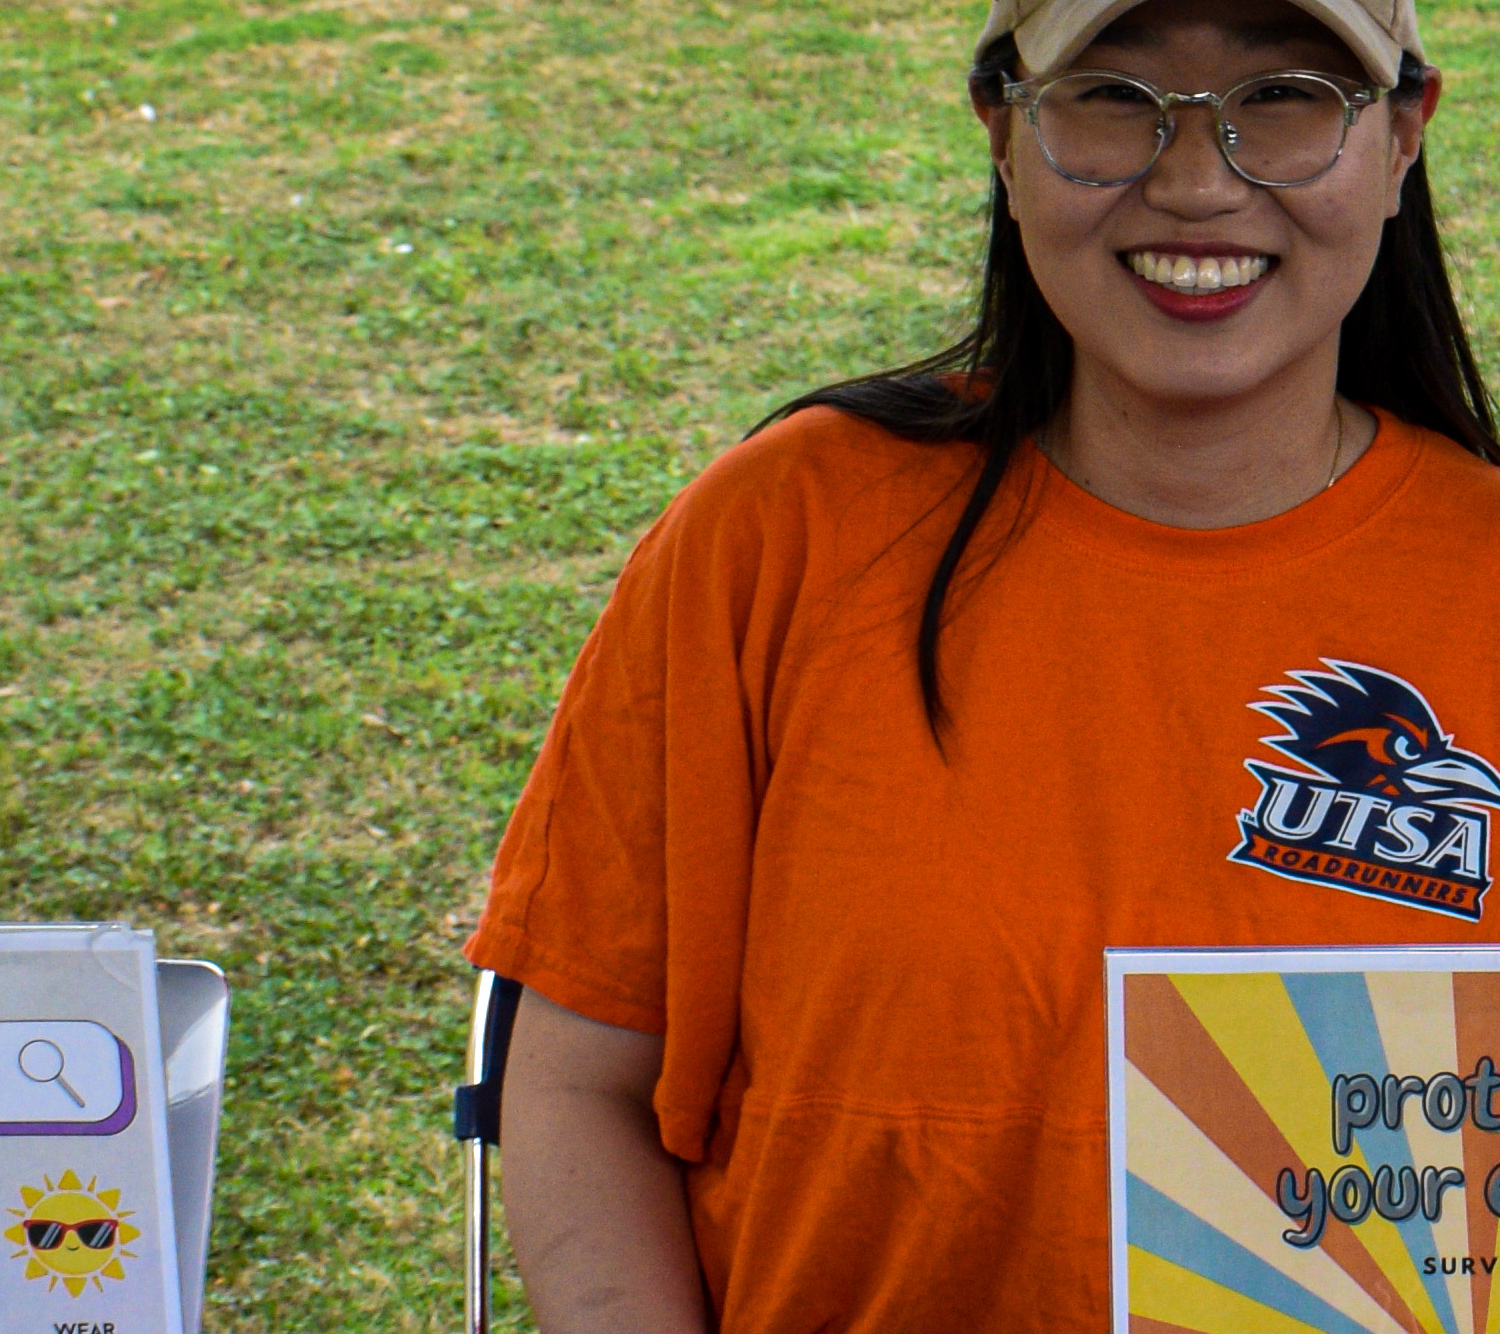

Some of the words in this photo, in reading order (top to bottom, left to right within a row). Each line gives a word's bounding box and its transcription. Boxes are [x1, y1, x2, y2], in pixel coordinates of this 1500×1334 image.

[1263, 777, 1482, 879] UTSA
[1263, 845, 1468, 905] ROADRUNNERS
[1276, 1164, 1466, 1247] your
